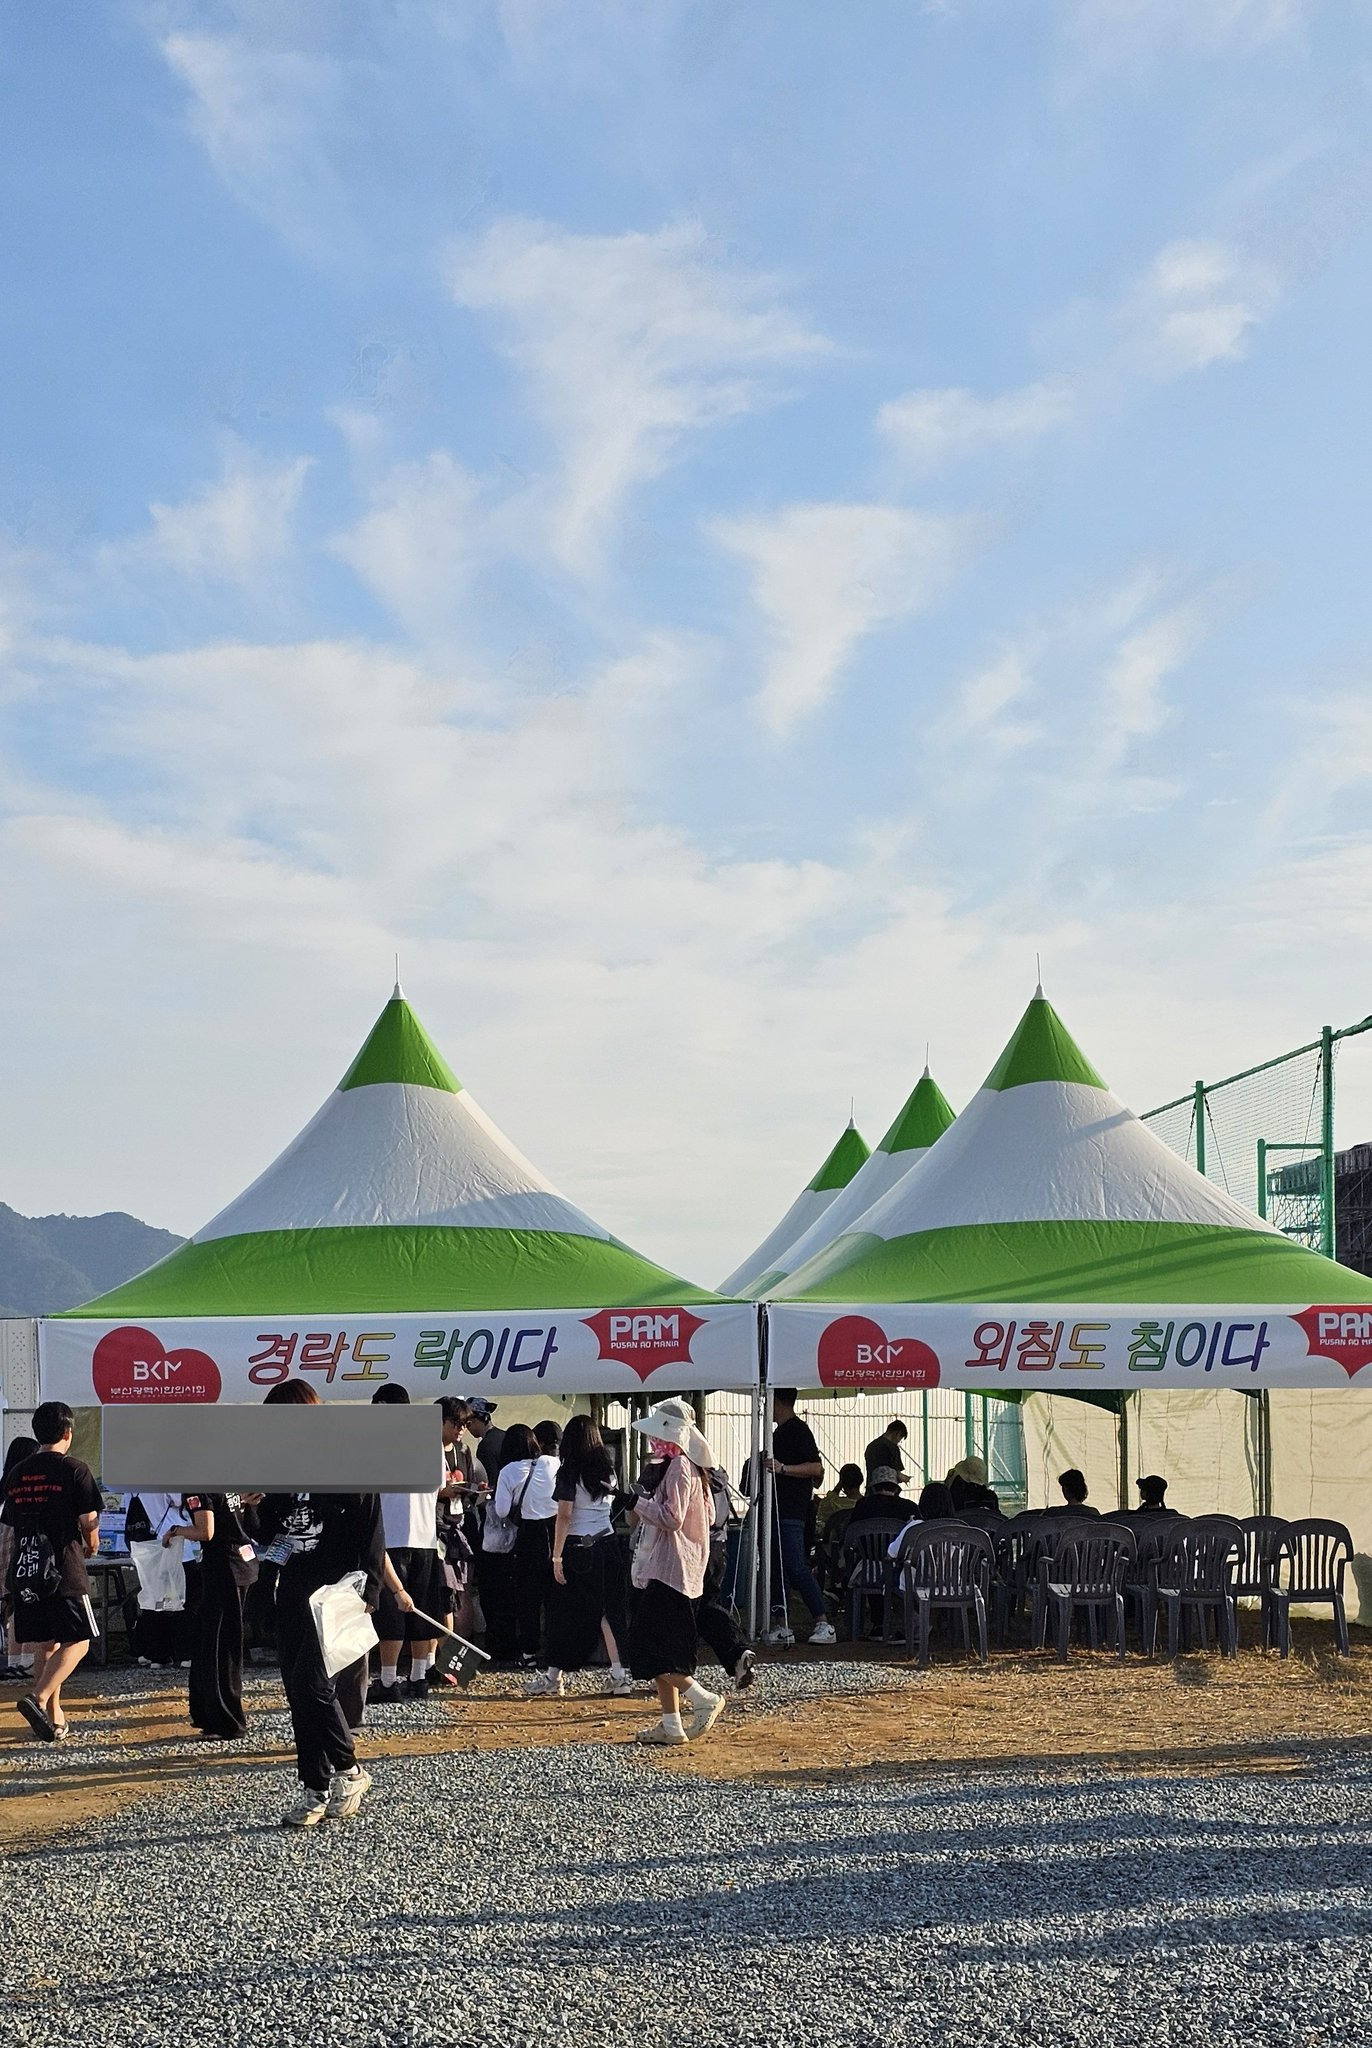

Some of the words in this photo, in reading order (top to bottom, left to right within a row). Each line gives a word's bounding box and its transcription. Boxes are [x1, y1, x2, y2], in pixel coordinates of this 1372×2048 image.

[610, 1314, 679, 1341] PAM
[611, 1341, 638, 1349] PUSAN
[653, 1340, 679, 1348] MANIA
[965, 1320, 1111, 1372] 외침도
[1127, 1321, 1270, 1372] 침이다
[1319, 1338, 1346, 1346] PUSAN
[248, 1331, 396, 1385] 경락도
[413, 1326, 559, 1381] 락이다
[857, 1344, 904, 1364] BKM
[133, 1360, 182, 1380] BKM
